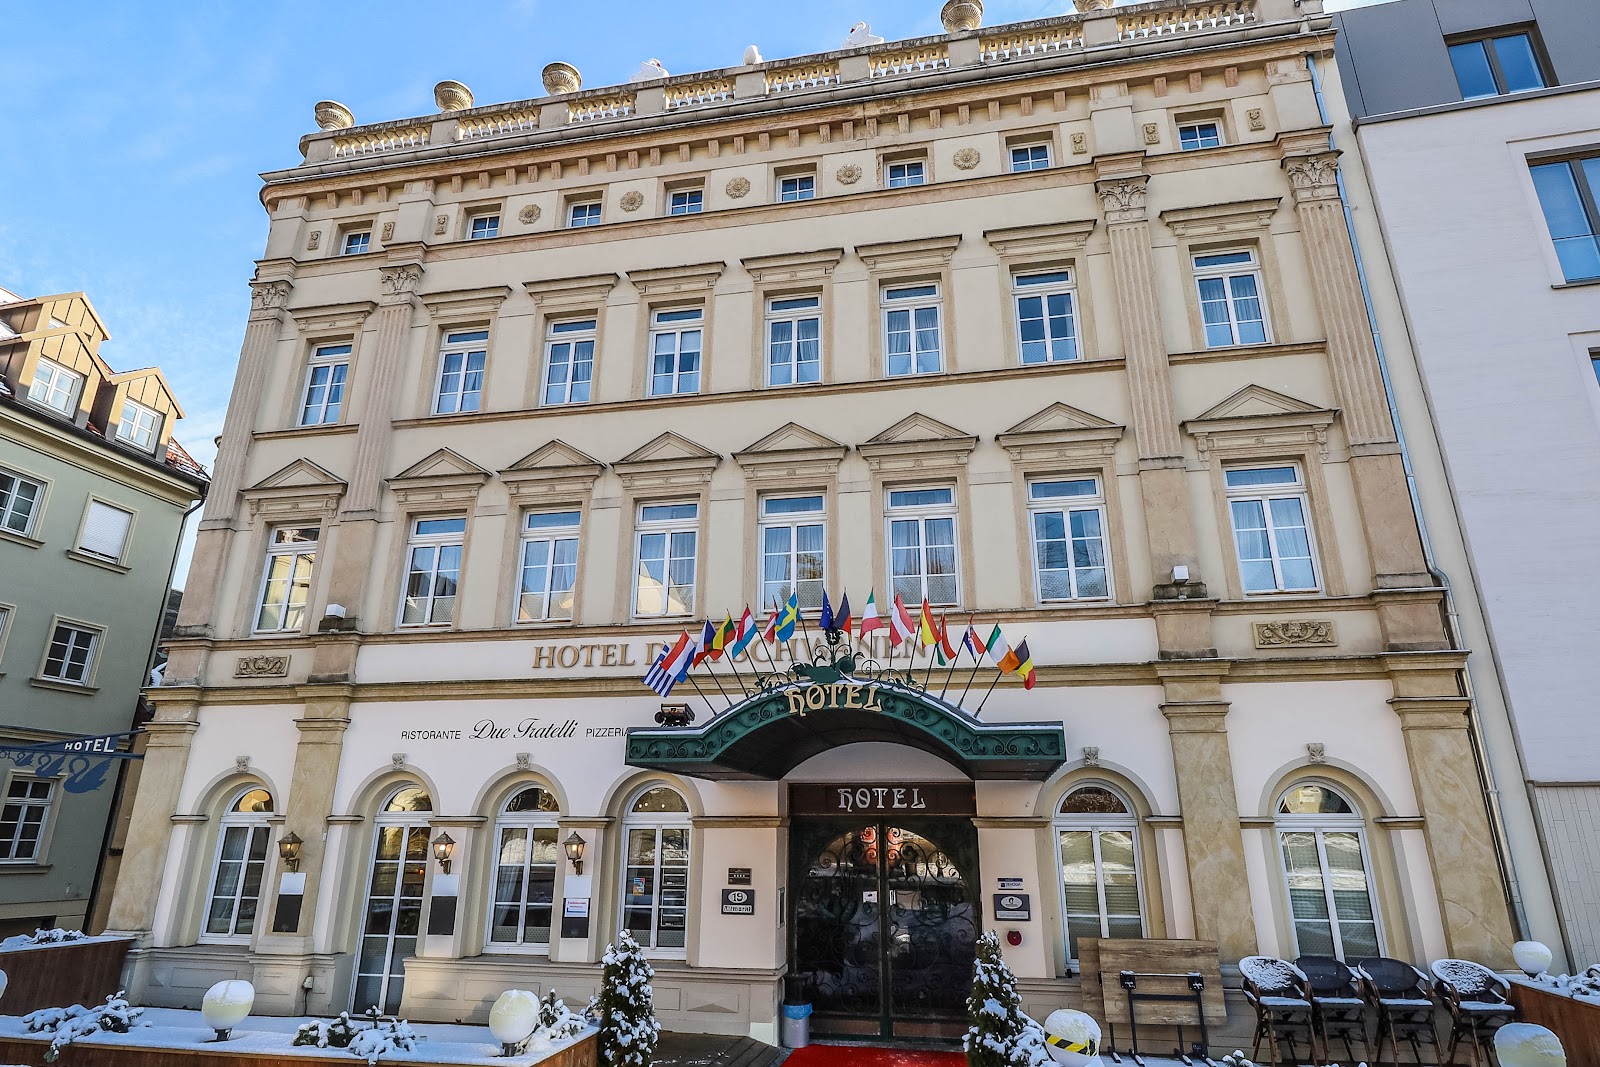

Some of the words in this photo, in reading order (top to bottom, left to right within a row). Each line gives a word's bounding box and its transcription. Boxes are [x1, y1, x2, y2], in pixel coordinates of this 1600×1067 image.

[532, 643, 636, 669] HOTEL
[783, 684, 883, 717] HOTEL
[401, 729, 462, 740] RISTORANTE
[469, 718, 511, 740] Due
[512, 717, 578, 739] Fratelli
[64, 736, 115, 753] HOTEL
[837, 787, 926, 812] HOTEL
[732, 892, 744, 902] 19
